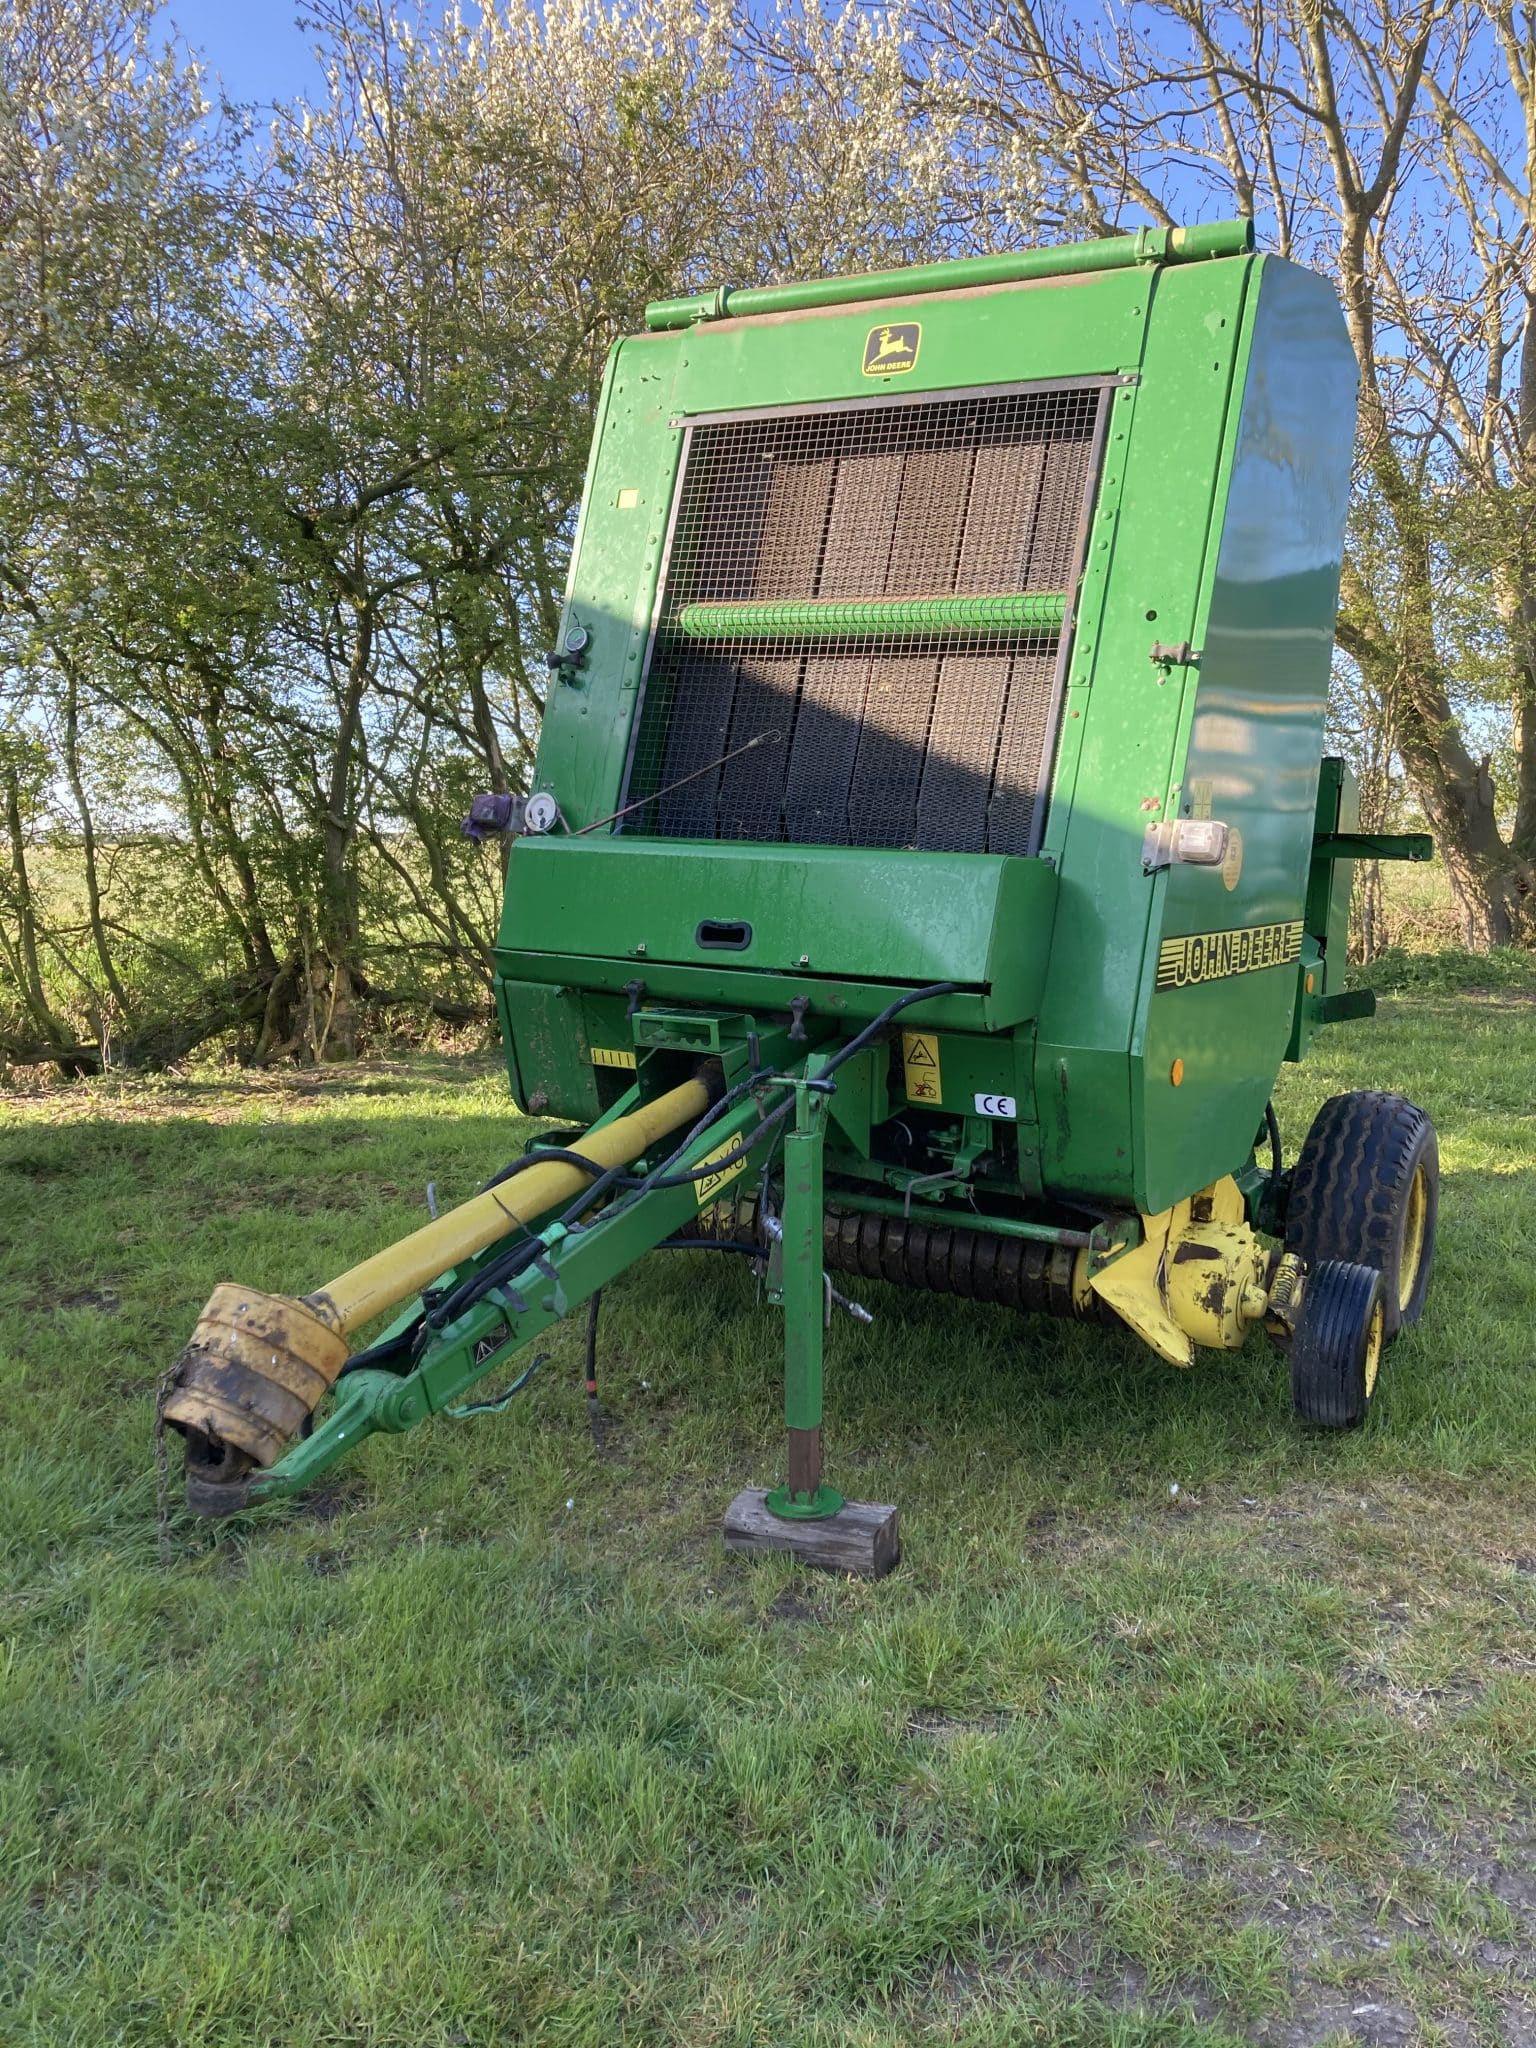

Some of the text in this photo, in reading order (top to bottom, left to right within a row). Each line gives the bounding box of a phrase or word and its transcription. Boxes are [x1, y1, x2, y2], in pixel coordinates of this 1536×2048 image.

[866, 360, 912, 372] JOHN DEERE
[1176, 924, 1292, 984] JOHN DEERE
[983, 1096, 1009, 1115] CE
